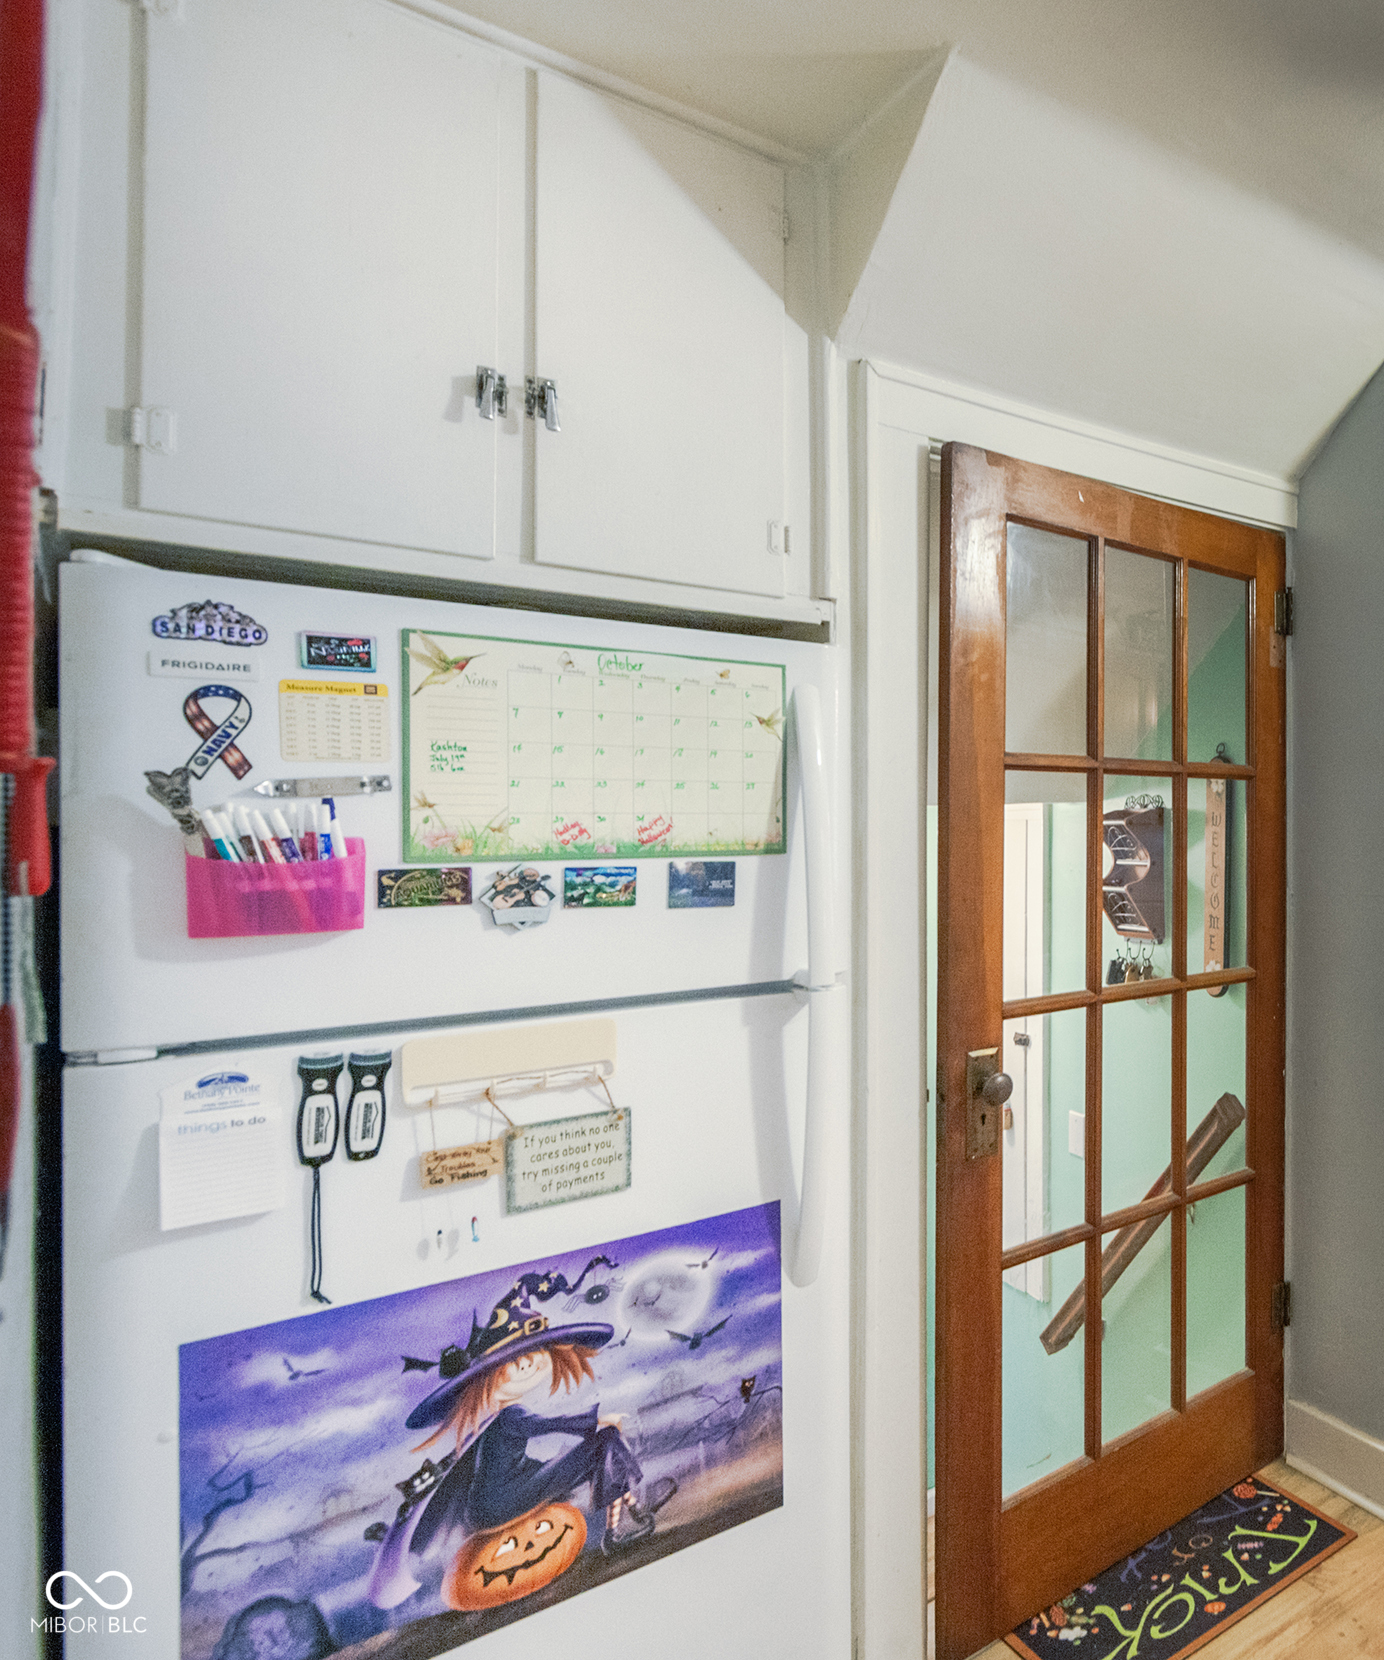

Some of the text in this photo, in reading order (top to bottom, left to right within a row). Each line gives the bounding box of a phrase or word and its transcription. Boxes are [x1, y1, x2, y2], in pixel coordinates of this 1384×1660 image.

[160, 620, 262, 641] SAN DIEGO
[160, 659, 252, 673] FRIGIDAIRE
[597, 653, 644, 672] October
[286, 683, 356, 695] Measure Magnet
[456, 672, 498, 688] Notes
[201, 721, 239, 757] NAVY
[429, 754, 449, 766] July
[1209, 811, 1222, 952] WELCOME
[184, 1088, 225, 1100] Bethany
[178, 1115, 266, 1135] things to do
[523, 1122, 620, 1149] If you think no one
[530, 1140, 615, 1163] cares about you,
[522, 1151, 623, 1182] try missing a couple
[429, 1169, 487, 1185] Go Fishing
[541, 1171, 605, 1193] of payments
[1170, 1533, 1214, 1567] or
